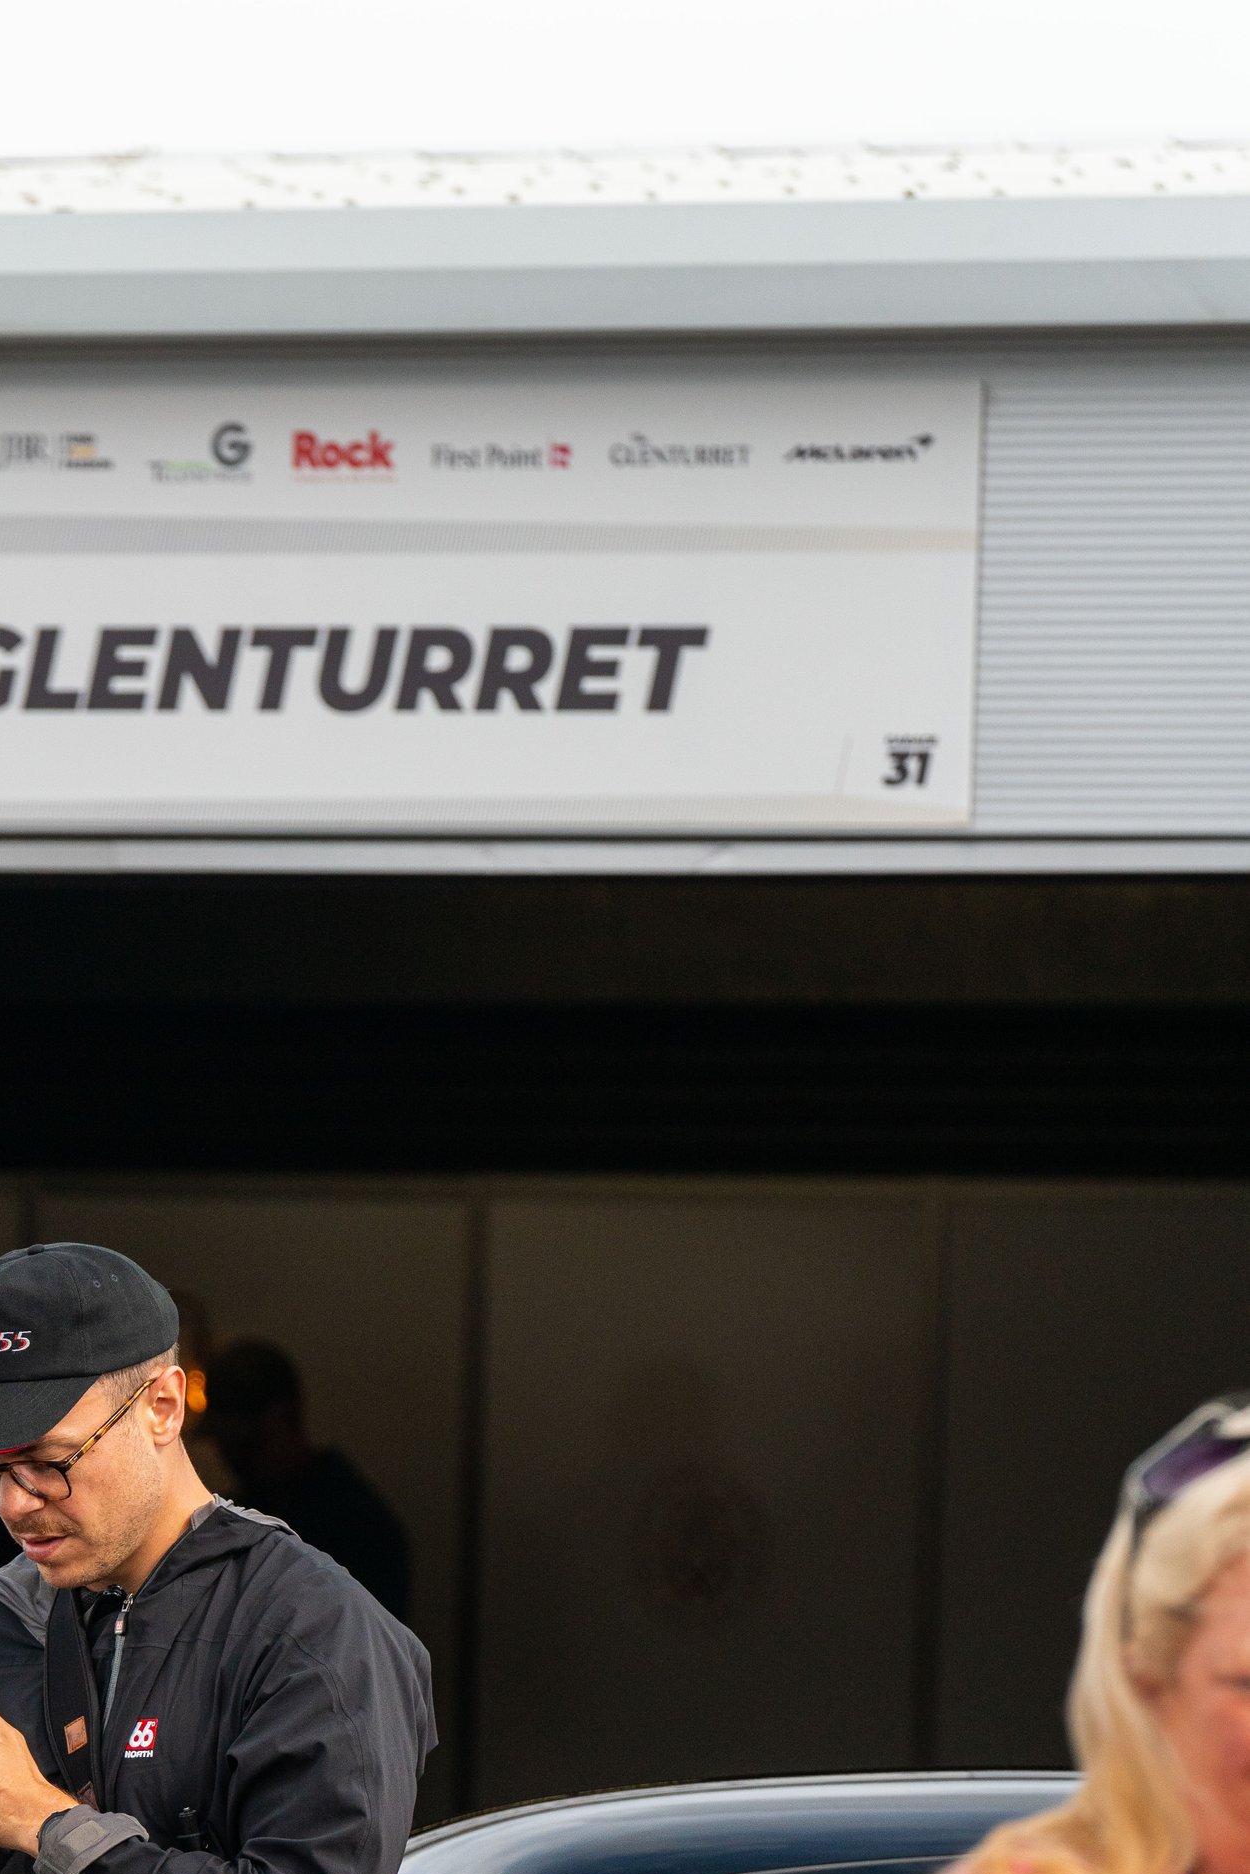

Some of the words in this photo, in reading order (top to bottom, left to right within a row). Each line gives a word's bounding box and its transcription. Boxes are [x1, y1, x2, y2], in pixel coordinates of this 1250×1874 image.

[292, 429, 395, 469] Rock
[881, 750, 931, 787] 31
[124, 1750, 154, 1758] NORTH
